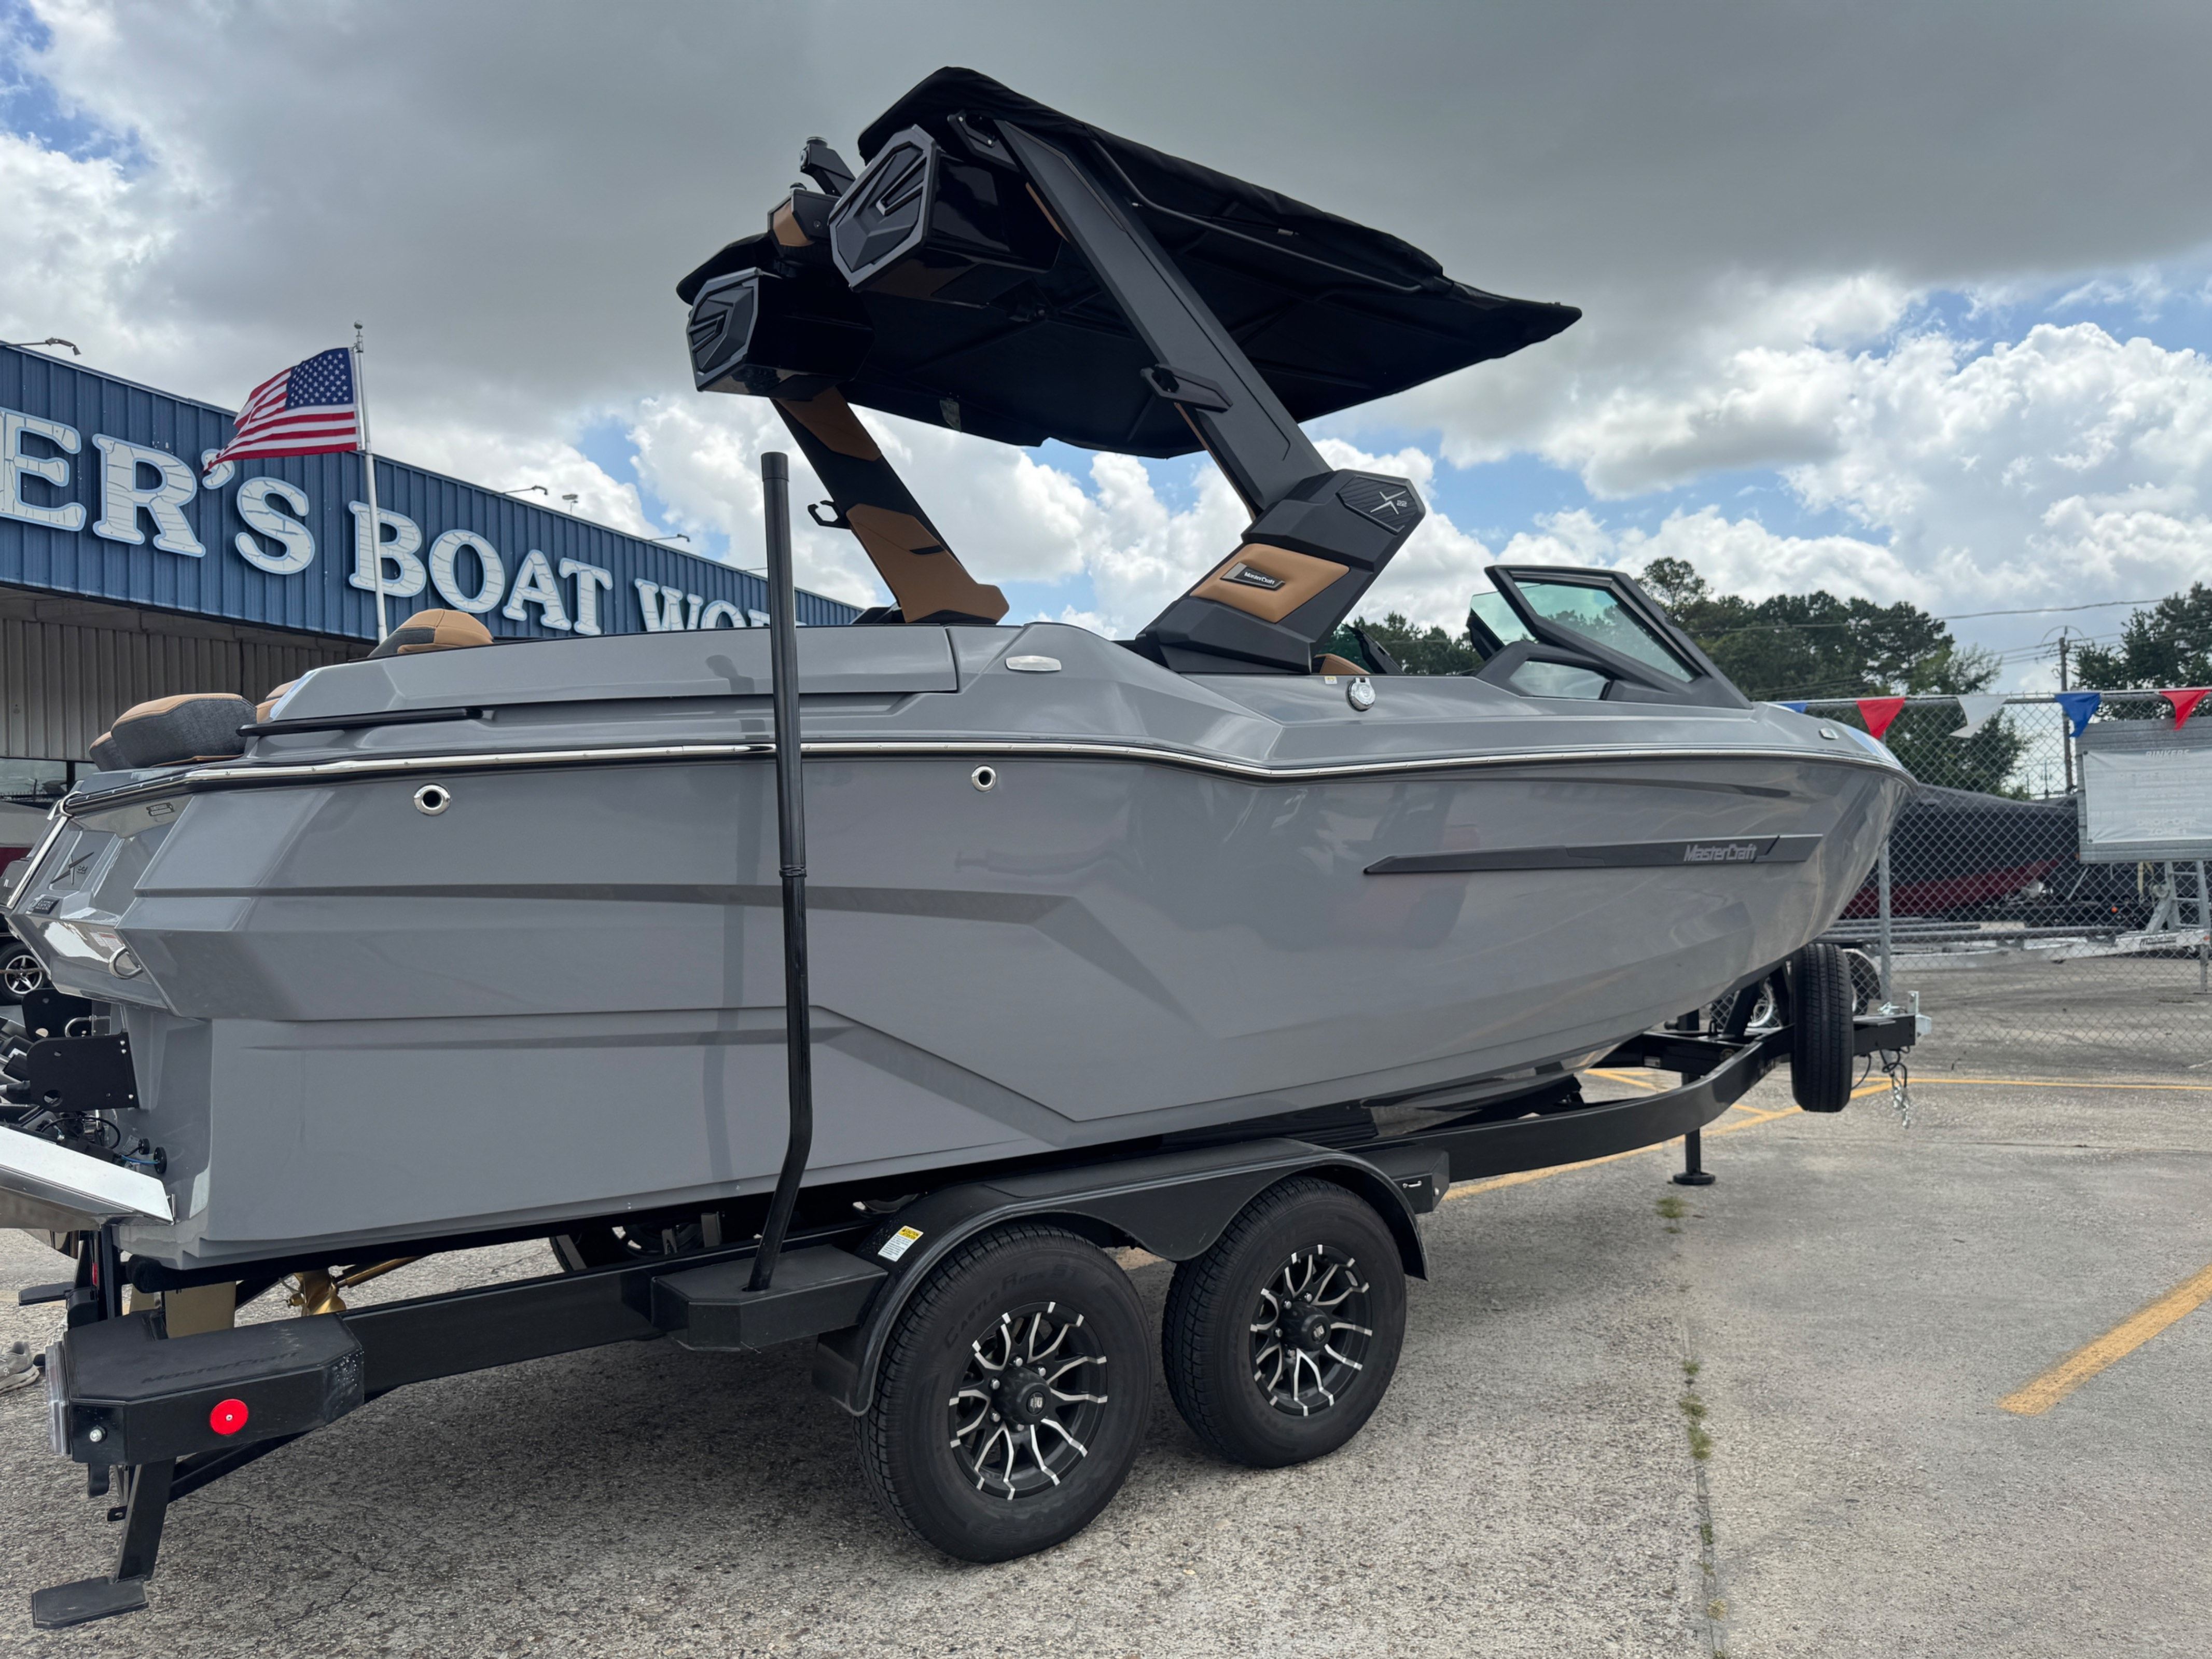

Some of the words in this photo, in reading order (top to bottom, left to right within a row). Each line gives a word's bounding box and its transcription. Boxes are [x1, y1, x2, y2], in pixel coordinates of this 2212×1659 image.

[349, 501, 613, 635] BOAT
[1244, 571, 1275, 585] MasterCraft
[1683, 843, 1757, 862] MasterCraft
[140, 1351, 299, 1385] MasterCraft
